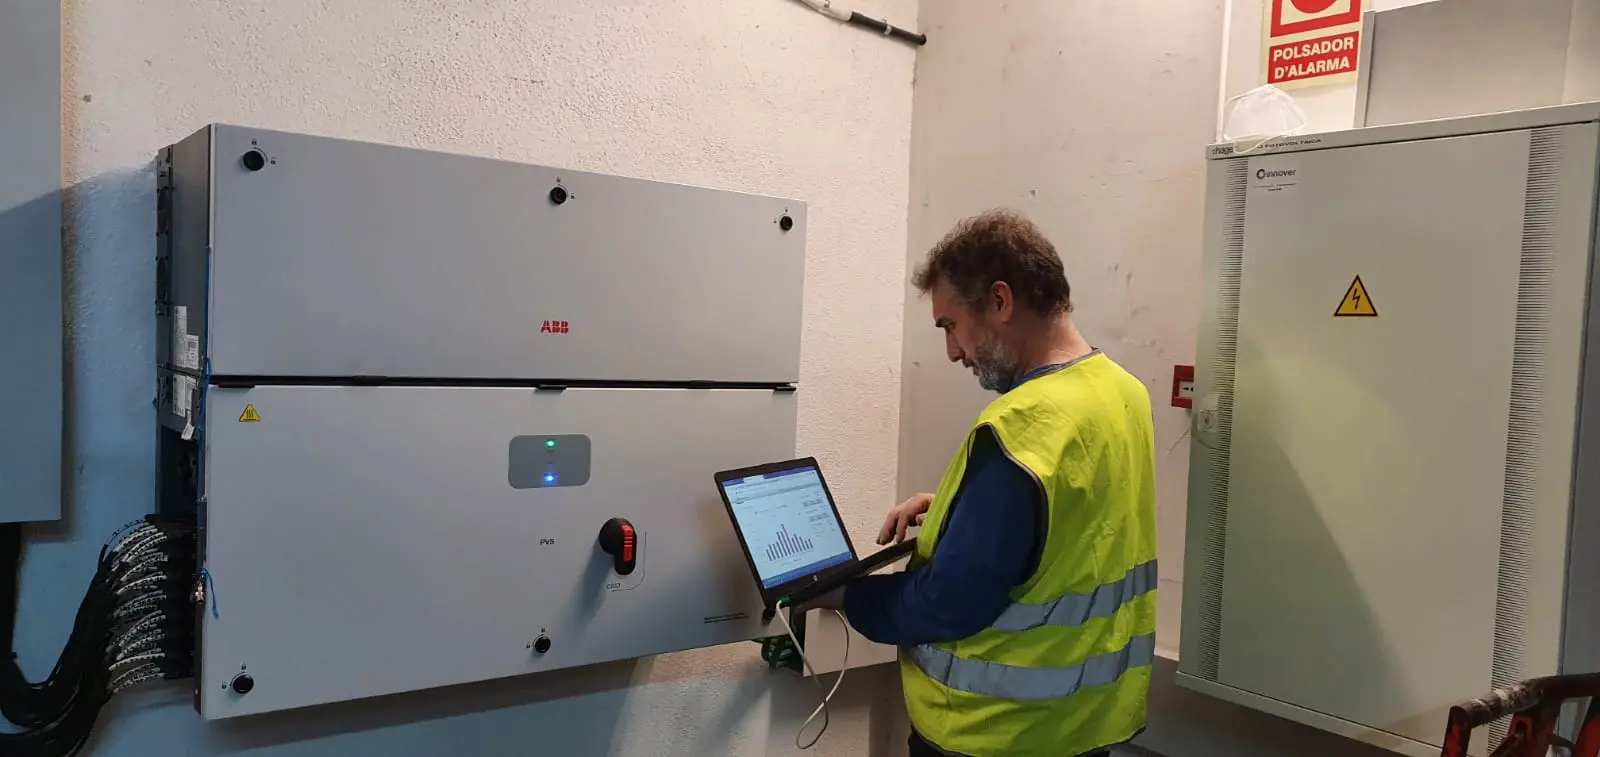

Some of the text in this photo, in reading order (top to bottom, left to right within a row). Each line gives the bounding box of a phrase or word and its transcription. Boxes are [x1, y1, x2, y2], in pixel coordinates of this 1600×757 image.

[1273, 37, 1354, 62] POLSADOR
[1274, 56, 1350, 79] D'ALARMA
[540, 319, 569, 333] ABB
